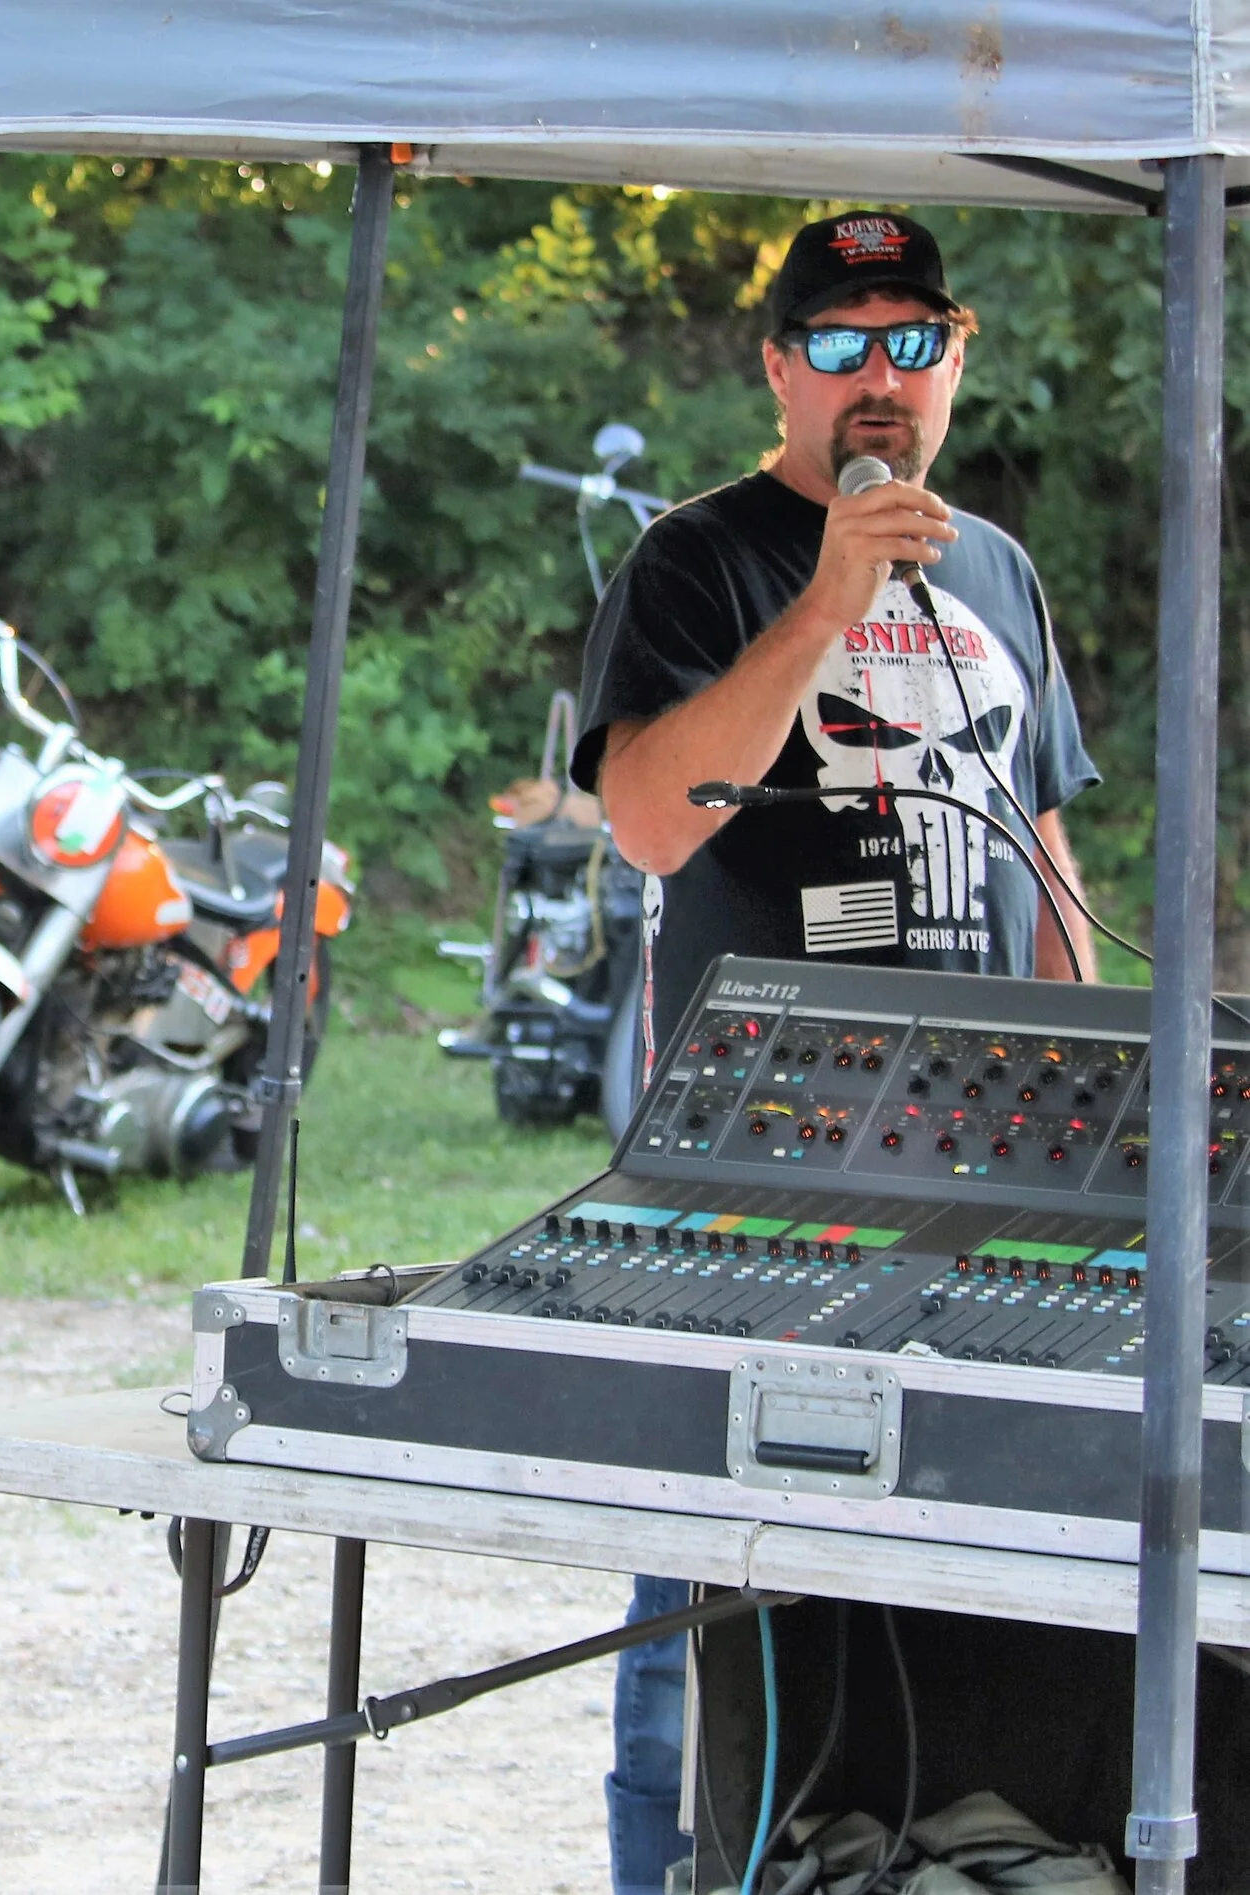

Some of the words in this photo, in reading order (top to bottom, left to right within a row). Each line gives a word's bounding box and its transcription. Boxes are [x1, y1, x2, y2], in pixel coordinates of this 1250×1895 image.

[844, 622, 988, 662] SNIPER
[851, 656, 875, 666] ONE
[859, 836, 901, 858] 1974
[905, 927, 955, 951] CHRIS
[717, 979, 801, 1001] iLive-T112
[244, 1527, 265, 1576] Cano
